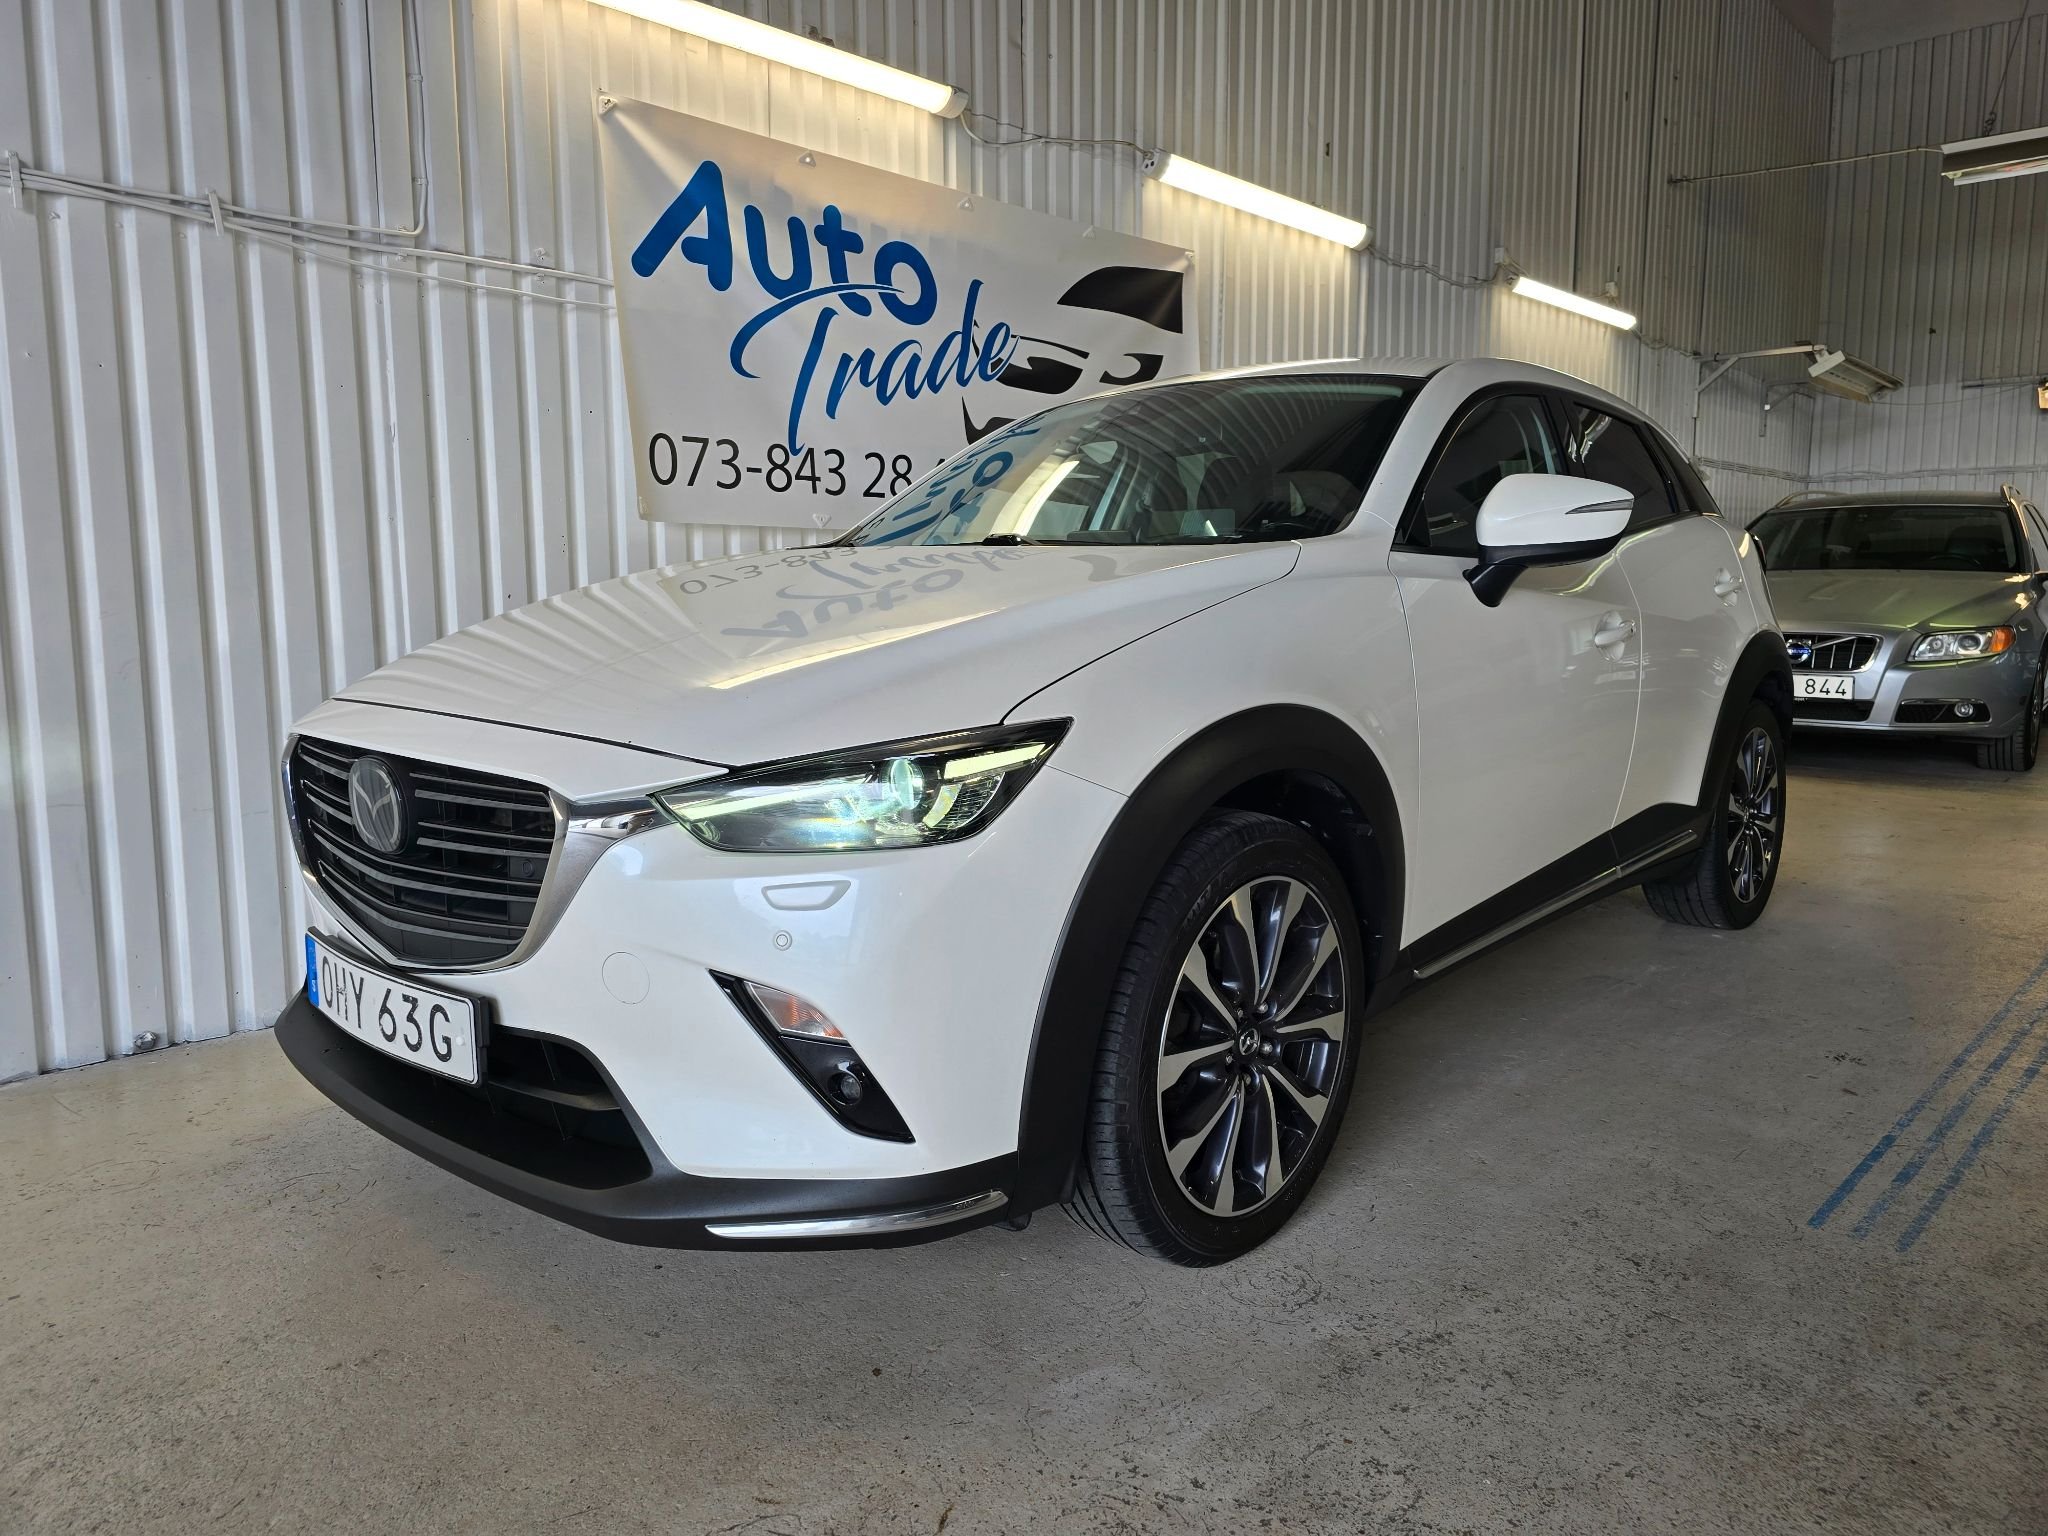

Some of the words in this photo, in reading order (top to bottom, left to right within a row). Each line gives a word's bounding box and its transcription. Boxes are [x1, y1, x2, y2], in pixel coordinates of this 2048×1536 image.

[631, 160, 938, 326] Auto
[729, 278, 1019, 457] Trade
[648, 432, 847, 496] 073-843
[862, 451, 913, 498] 28
[1804, 678, 1847, 697] 844
[322, 956, 364, 1029] OHY
[378, 988, 452, 1062] 63G
